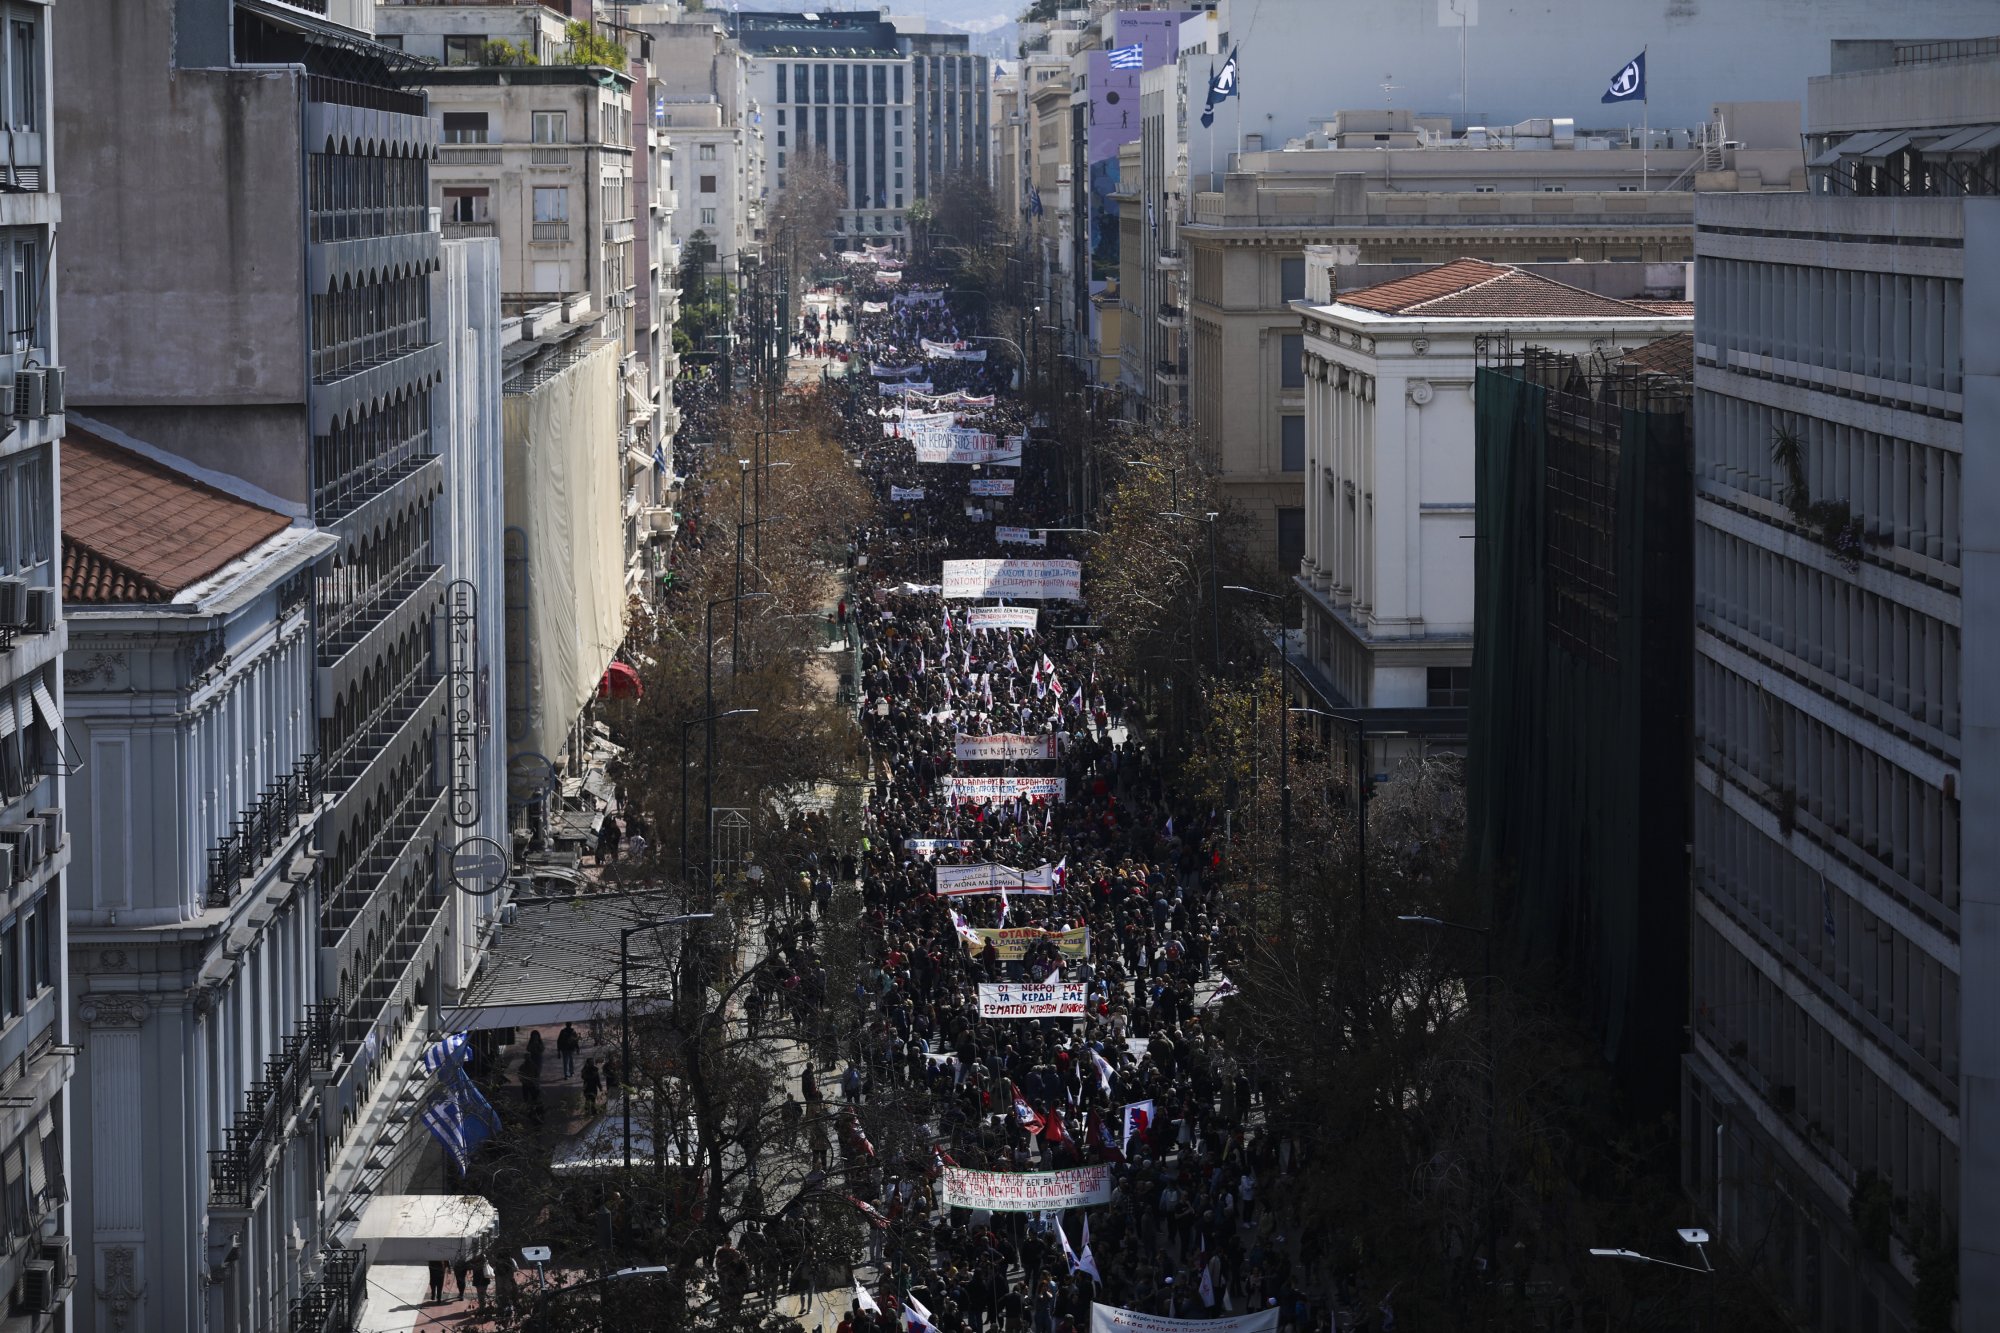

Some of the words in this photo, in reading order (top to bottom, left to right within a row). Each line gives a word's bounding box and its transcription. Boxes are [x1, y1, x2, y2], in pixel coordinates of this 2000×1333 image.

[979, 785, 1016, 793] ΠΡΟΣΤΣΙΑΣ
[998, 929, 1041, 939] ΦΤΑΝΕΙ
[998, 984, 1008, 992] ΟΙ
[1021, 984, 1055, 992] ΝΕΚΡΟΙ
[1063, 984, 1084, 992] ΜΑΣ
[999, 994, 1010, 1002] ΤΑ
[1022, 993, 1052, 1002] ΚΕΡΔΗ
[1062, 992, 1083, 1001] ΣΑΣ
[984, 1004, 1027, 1015] ΣΩΜΑΤΕΙΟ
[1026, 1178, 1040, 1187] ΔΕΝ
[988, 1186, 1022, 1198] ΝΕΚΡΩΝ
[1040, 1183, 1075, 1197] ΓΙΝΟΥΜΕ
[1080, 1180, 1101, 1193] ΦΩΝΗ
